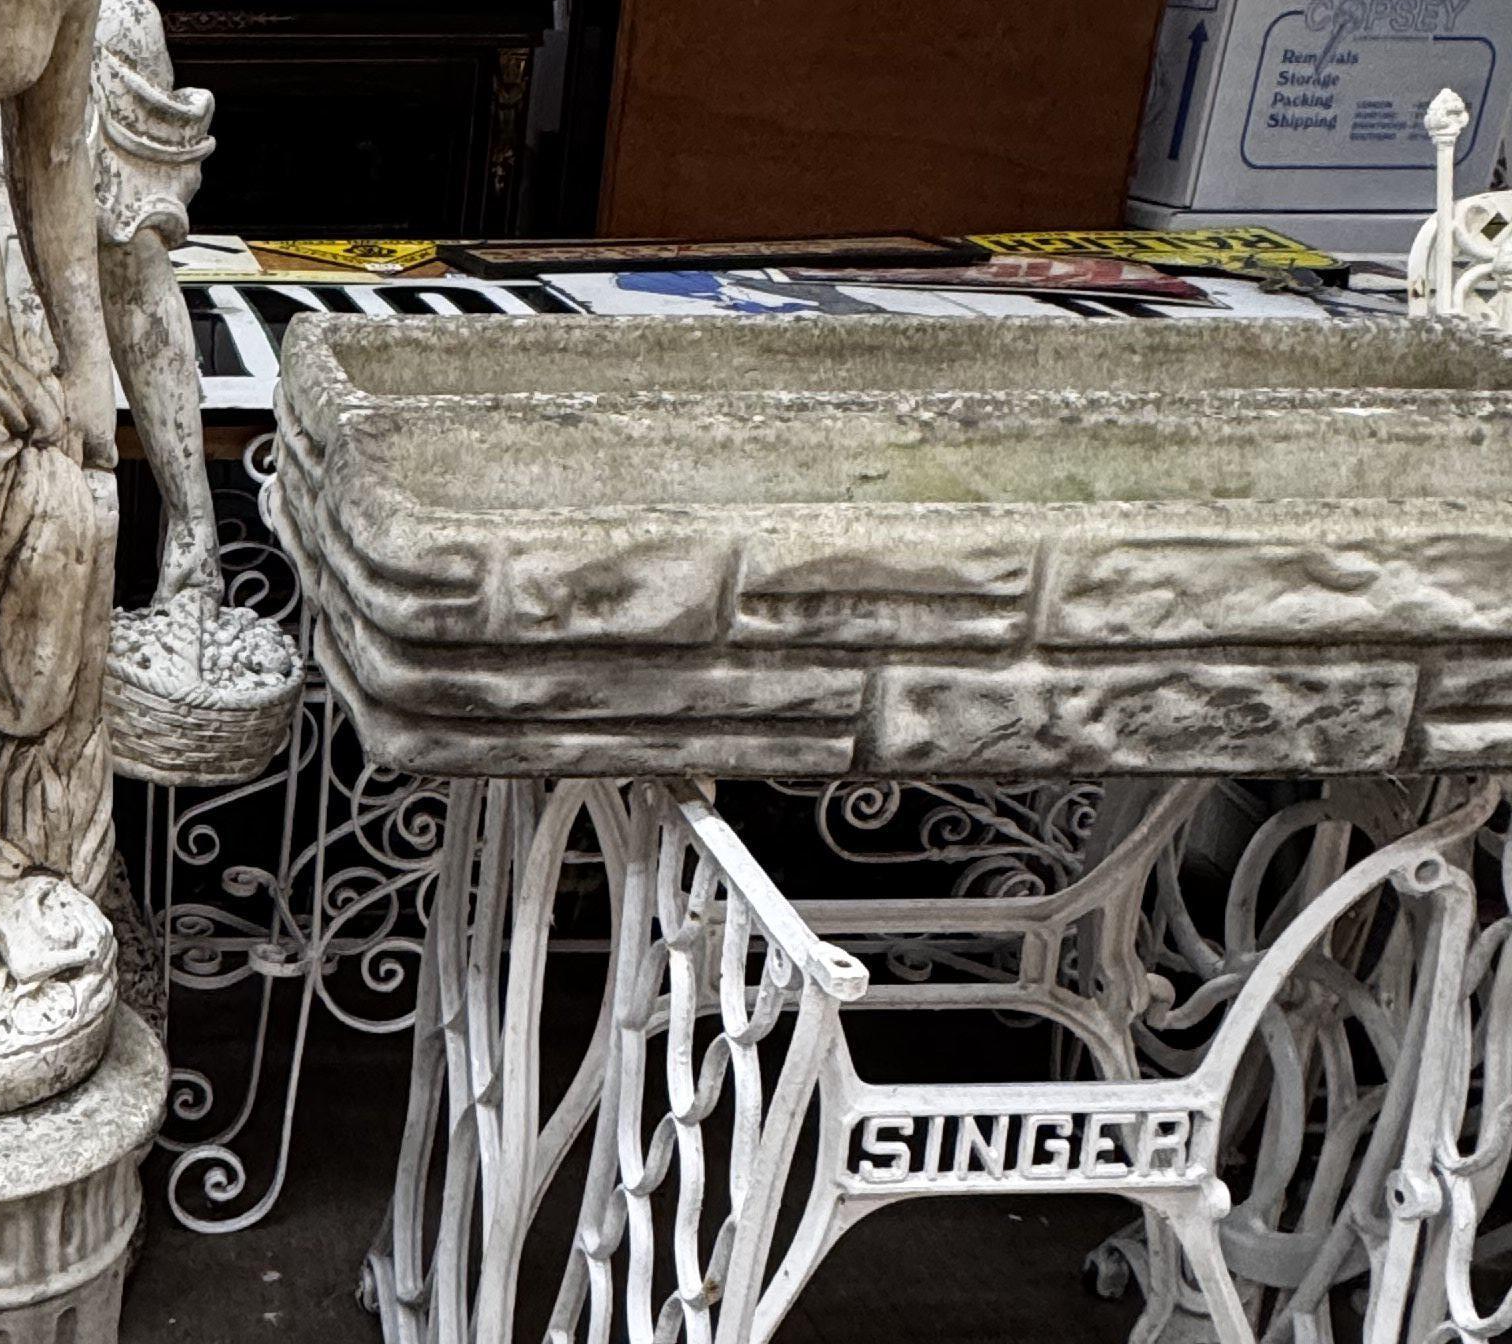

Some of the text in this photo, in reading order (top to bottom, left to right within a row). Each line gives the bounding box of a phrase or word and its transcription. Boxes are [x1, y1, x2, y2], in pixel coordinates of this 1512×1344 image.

[1276, 70, 1340, 87] Storage
[1271, 91, 1334, 110] Packing
[1266, 112, 1339, 131] Shipping
[987, 235, 1292, 253] RALEIGH
[857, 1112, 1192, 1184] SINGER
